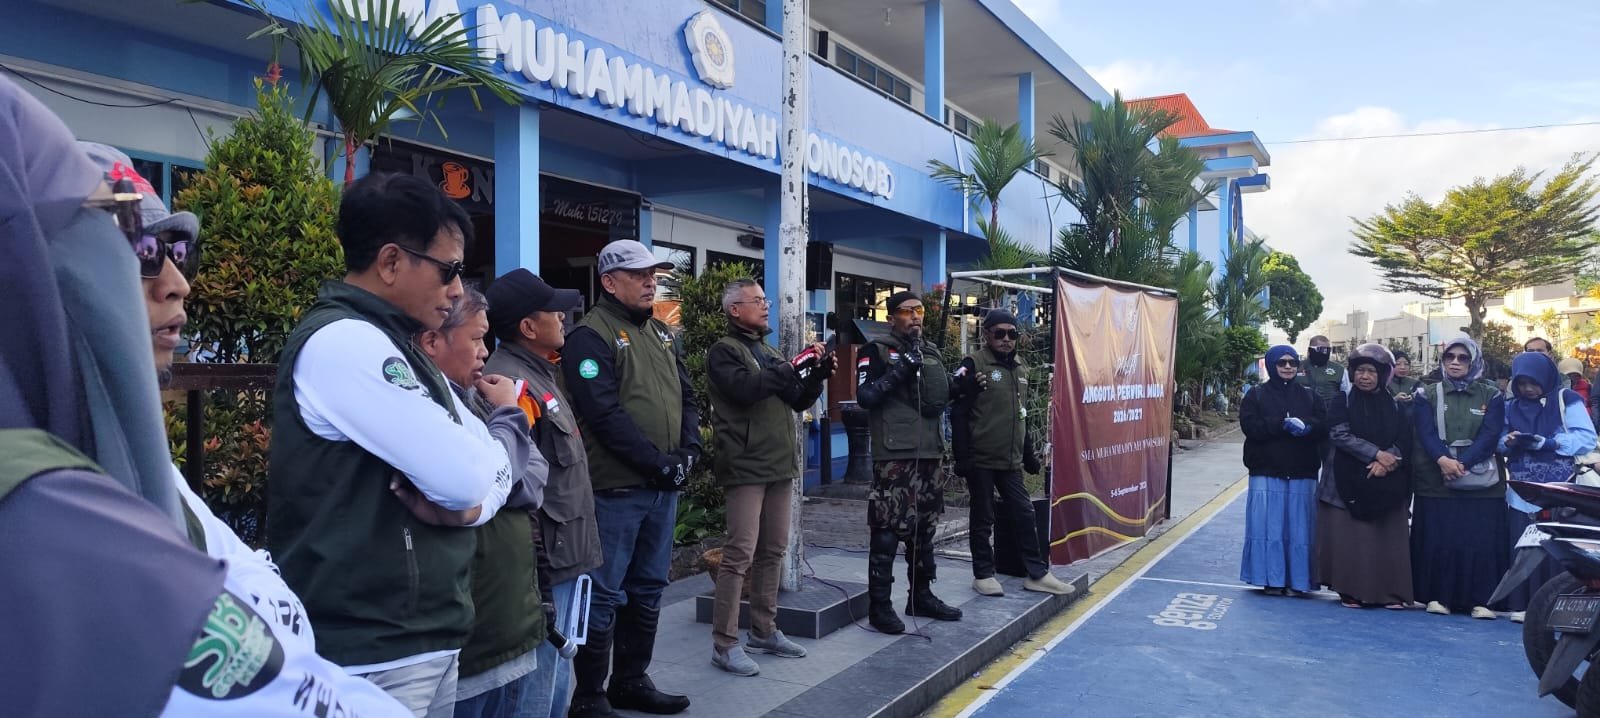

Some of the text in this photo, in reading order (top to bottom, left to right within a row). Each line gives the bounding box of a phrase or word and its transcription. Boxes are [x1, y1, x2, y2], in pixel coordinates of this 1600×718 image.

[476, 3, 777, 160] MUHAMMADIYAH
[801, 129, 895, 200] ONOSOBO
[553, 199, 623, 226] Muhi 151279
[1082, 385, 1115, 404] ANGGOTA
[1081, 449, 1095, 462] SMA
